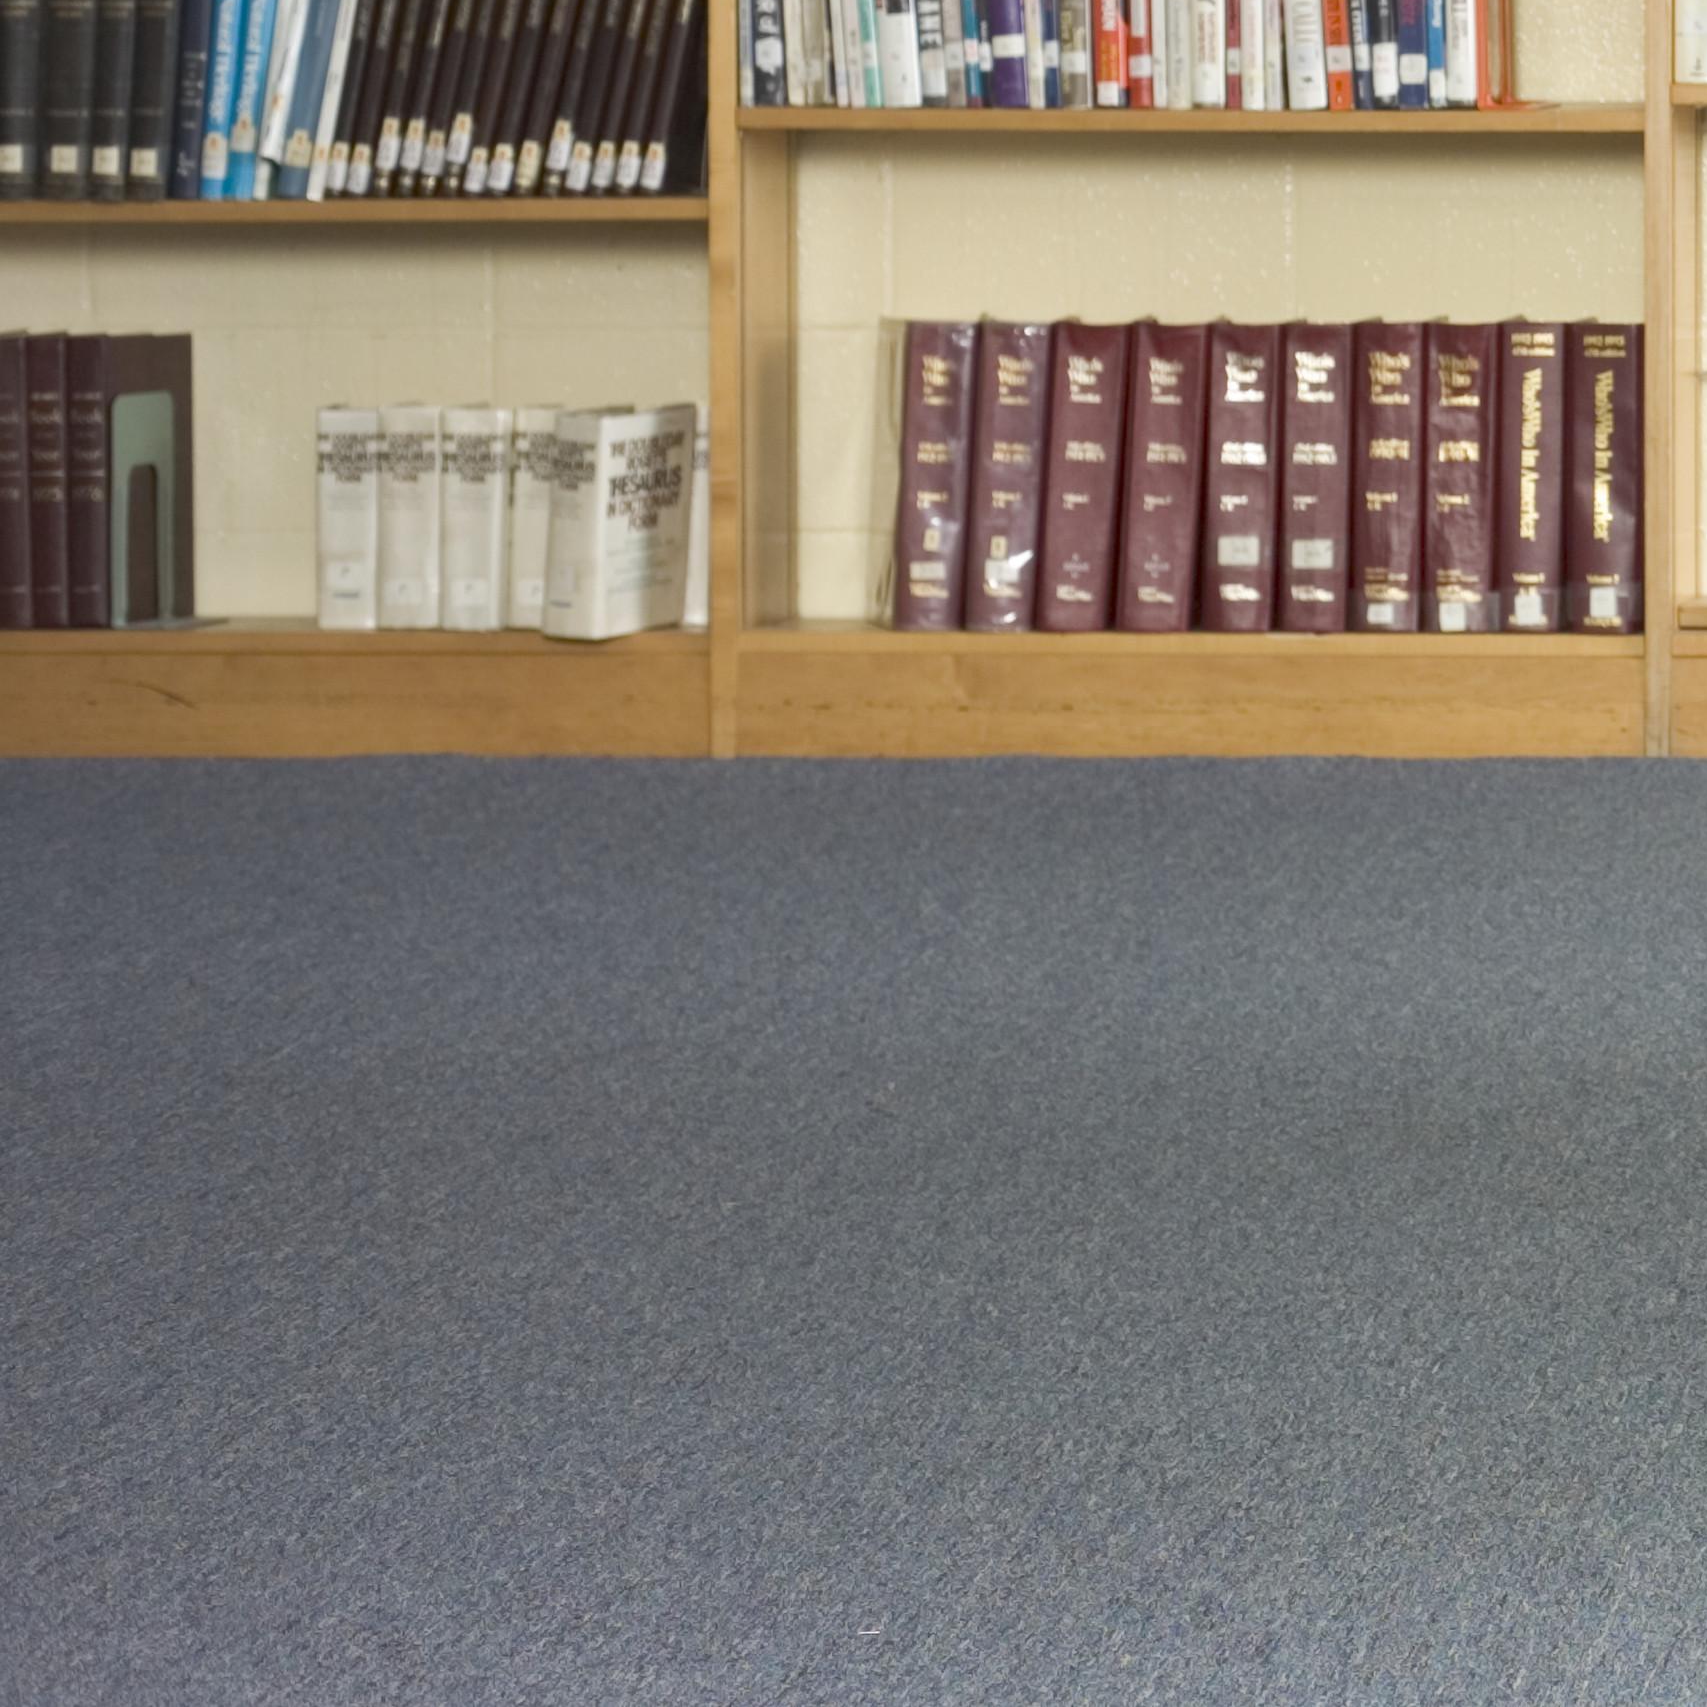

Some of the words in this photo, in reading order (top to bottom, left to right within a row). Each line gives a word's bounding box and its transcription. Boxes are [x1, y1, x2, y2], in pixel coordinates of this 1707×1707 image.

[609, 466, 682, 497] THESAURUS
[1519, 471, 1540, 541] America
[1593, 471, 1613, 542] America
